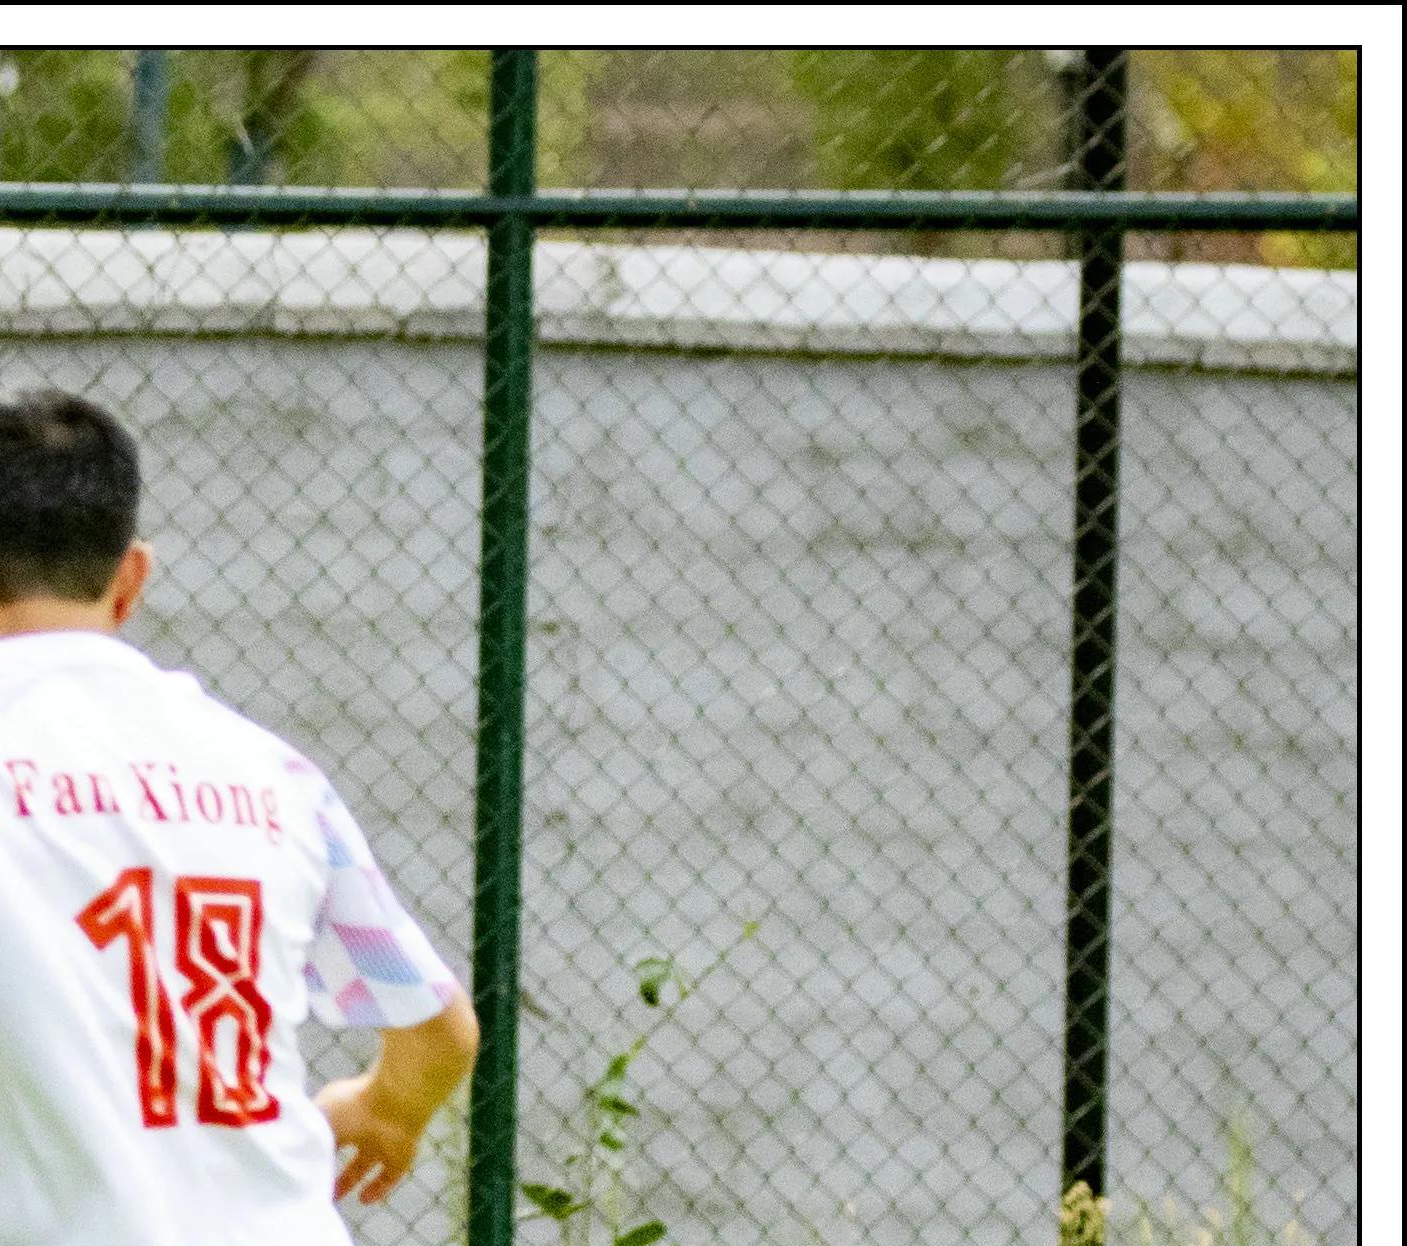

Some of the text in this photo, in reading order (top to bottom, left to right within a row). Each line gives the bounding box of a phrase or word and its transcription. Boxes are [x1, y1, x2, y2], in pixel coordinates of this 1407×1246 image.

[3, 758, 284, 847] Fan Xiong
[76, 865, 281, 1129] 18
